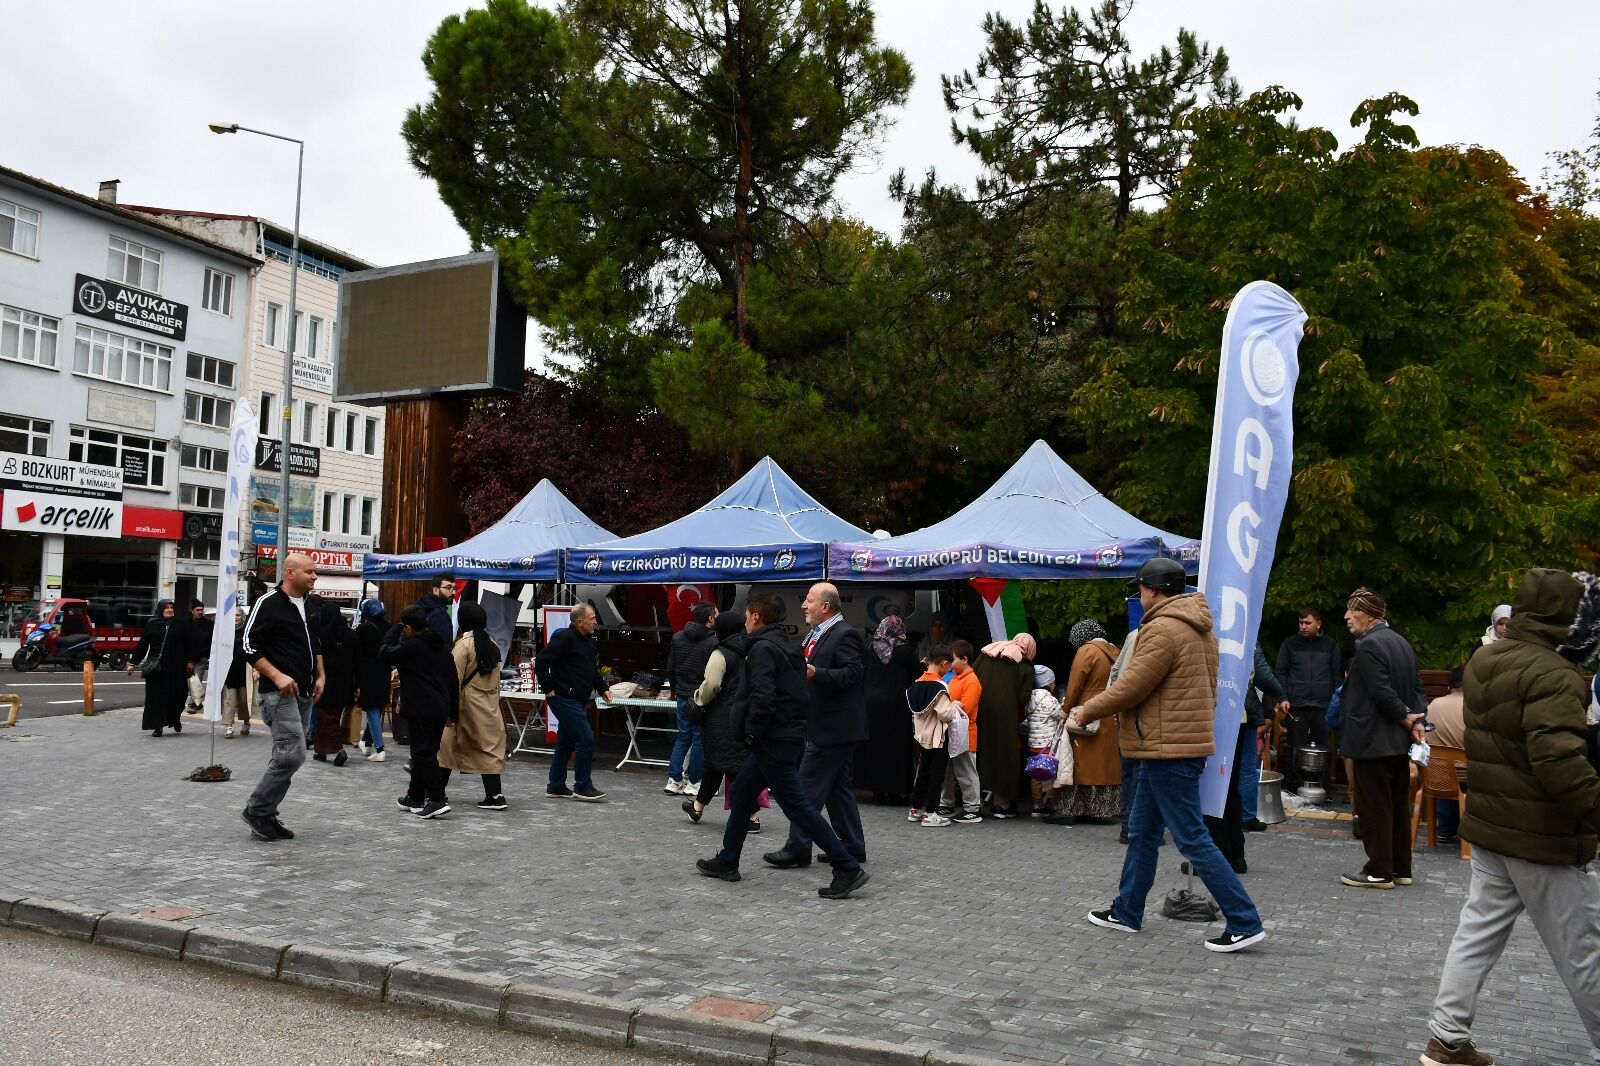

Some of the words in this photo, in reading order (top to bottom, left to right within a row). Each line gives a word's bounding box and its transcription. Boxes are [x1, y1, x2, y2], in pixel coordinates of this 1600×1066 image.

[116, 289, 178, 316] AVUKAT
[107, 300, 138, 317] SEFA
[140, 310, 183, 329] SARIER
[293, 359, 307, 369] ARİTA
[307, 362, 332, 376] KADASTRO
[21, 460, 76, 482] BOZKURT
[79, 465, 121, 479] MÜHENDİSLİK
[86, 477, 117, 490] MİMARLIK
[40, 505, 114, 532] arçelik
[135, 525, 166, 534] arcelik.com.tr
[327, 539, 348, 549] TÜRKİYE
[349, 541, 370, 551] SİGORTA
[310, 551, 349, 566] OPTİK
[611, 553, 687, 573] VEZİRKÖPRÜ
[689, 552, 764, 569] BELEDİYESİ
[886, 544, 984, 570] VEZİRKÖPRÜ
